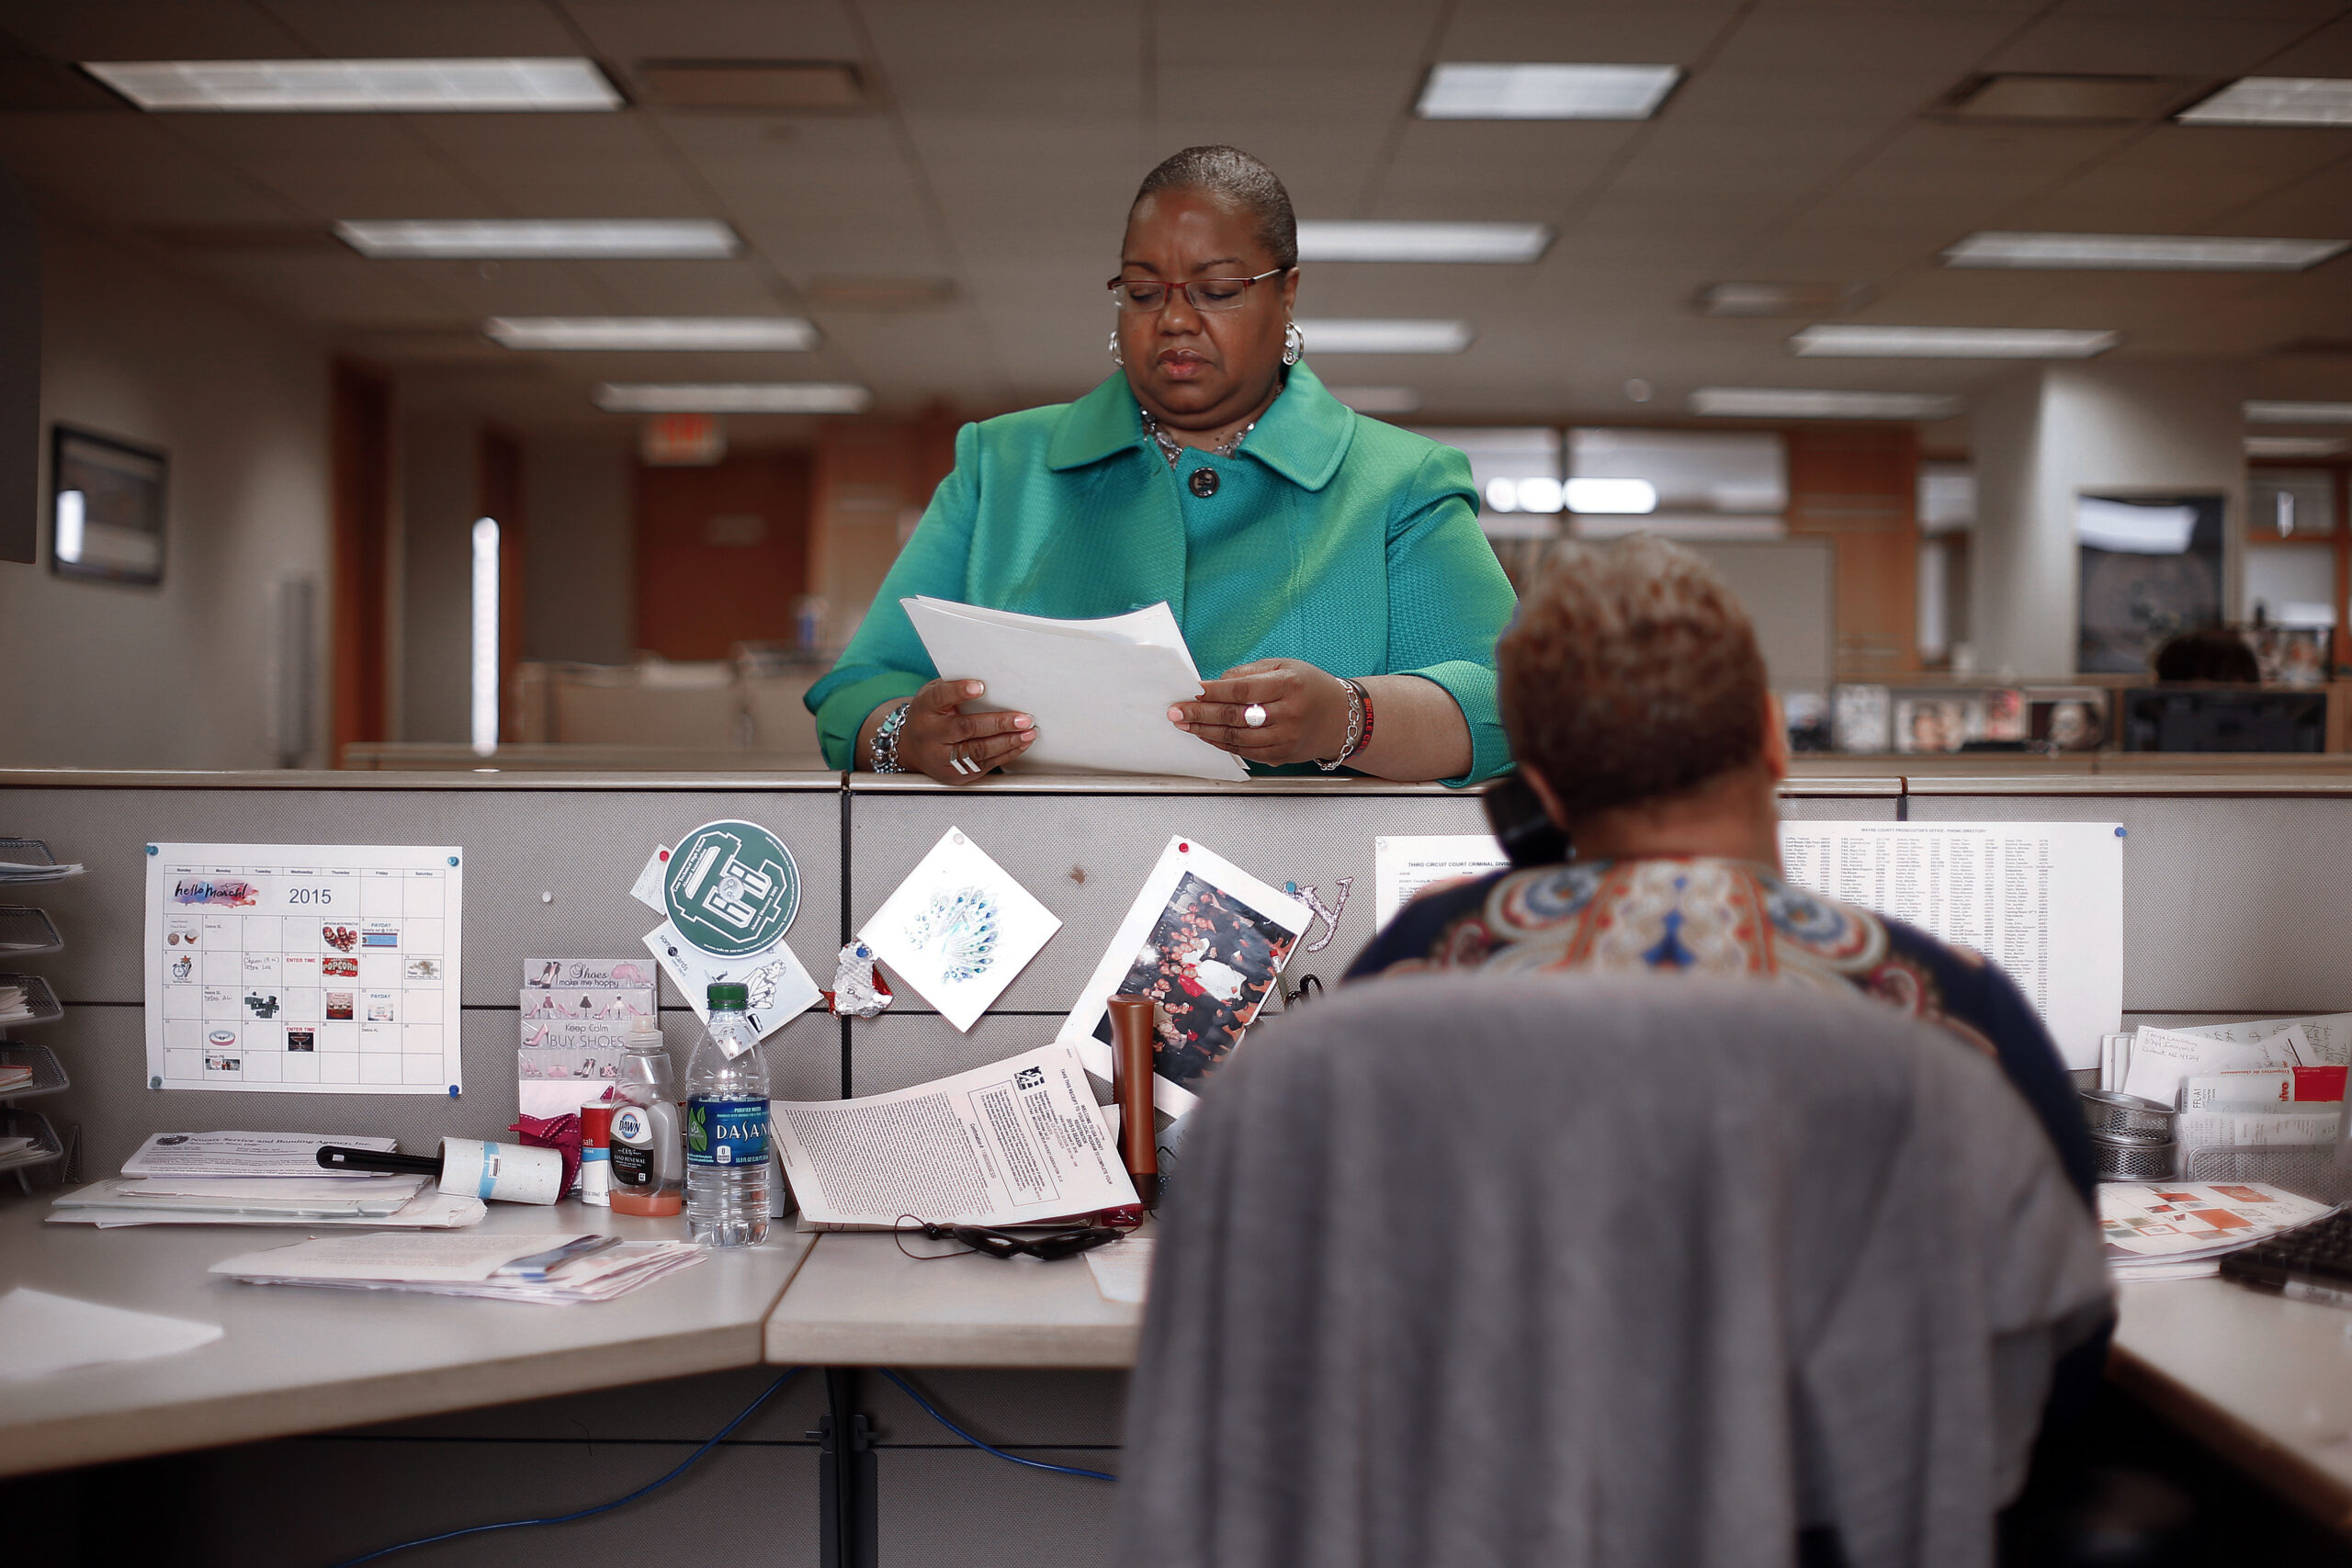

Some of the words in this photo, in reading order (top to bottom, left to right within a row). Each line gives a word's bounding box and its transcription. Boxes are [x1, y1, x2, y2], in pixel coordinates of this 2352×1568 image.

[678, 861, 692, 881] Technical
[175, 880, 204, 897] hello
[289, 889, 331, 904] 2015
[323, 962, 357, 971] POPCORN
[569, 962, 609, 979] Shoes
[595, 979, 619, 988] happy
[566, 1024, 586, 1034] Keep
[588, 1023, 608, 1032] Calm
[551, 1036, 574, 1047] BUY
[580, 1036, 625, 1047] SHOES
[619, 1120, 641, 1133] DAWN
[969, 1122, 983, 1145] Confirmation
[1068, 1088, 1078, 1105] RECEIPT
[1081, 1122, 1089, 1134] LOCAL
[1087, 1134, 1097, 1151] PROGRAM
[1096, 1155, 1107, 1174] COMPLETE
[1073, 1118, 1087, 1144] REGISTRATION
[1080, 1104, 1091, 1124] WELCOME
[1094, 1136, 1103, 1151] HOCKEY
[1072, 1131, 1082, 1147] SEASON
[625, 1156, 646, 1164] RENEWAL
